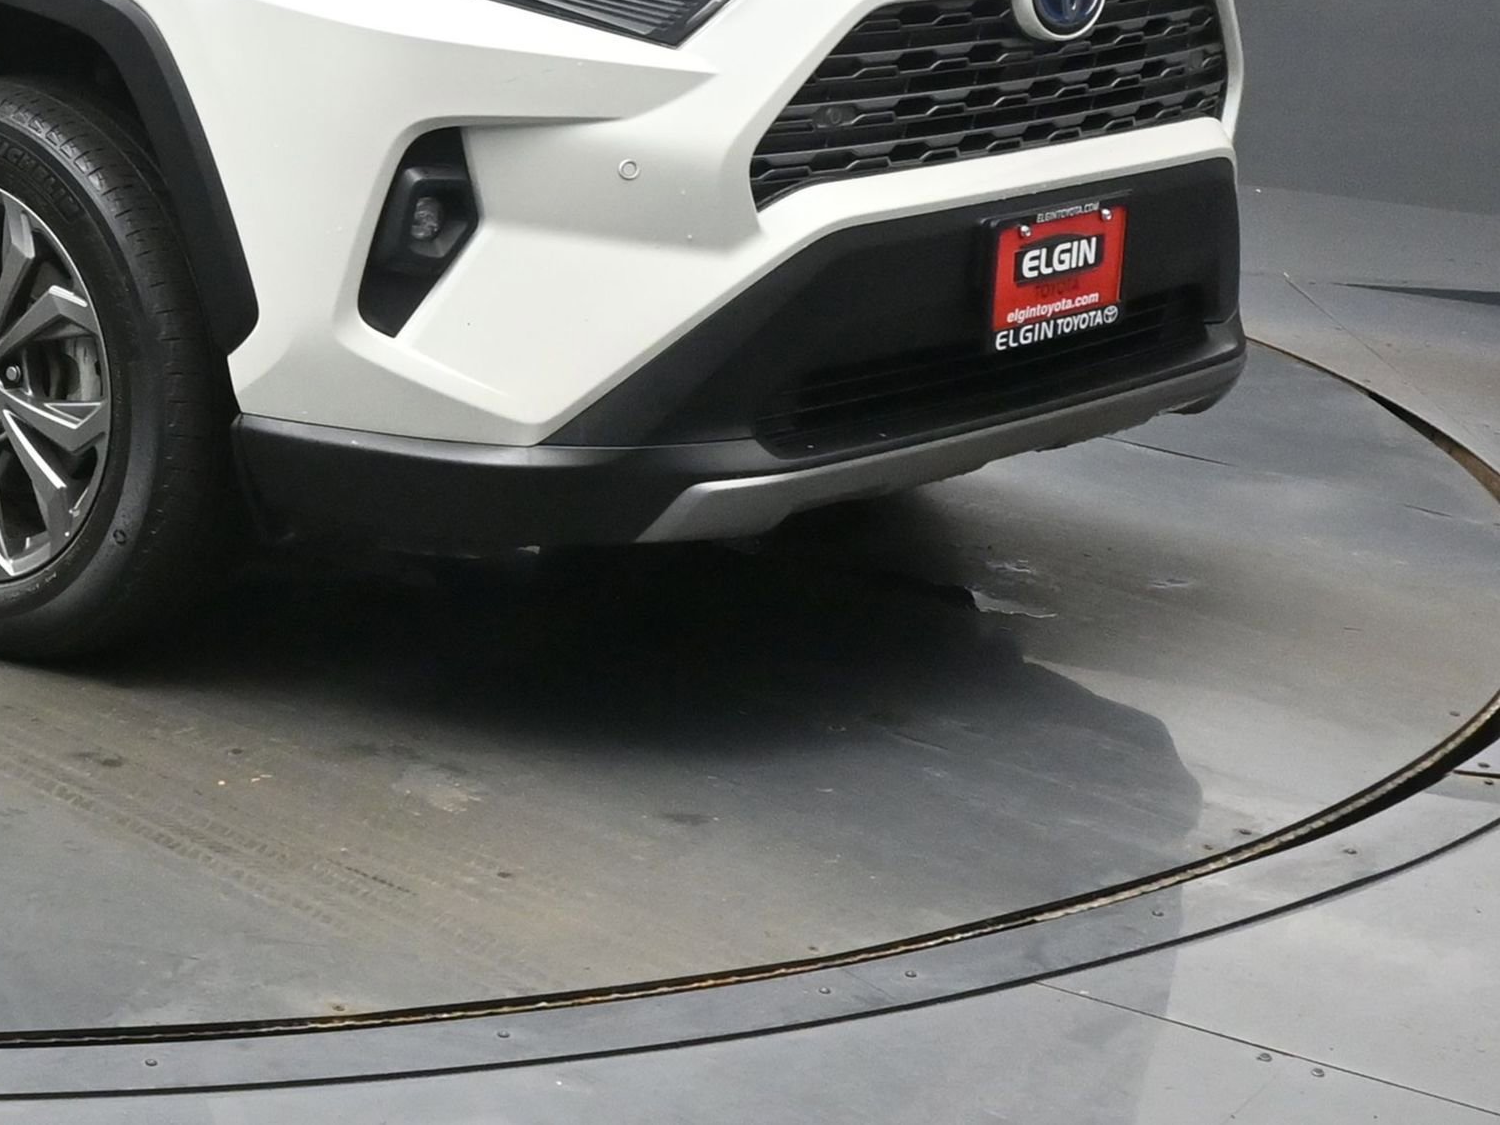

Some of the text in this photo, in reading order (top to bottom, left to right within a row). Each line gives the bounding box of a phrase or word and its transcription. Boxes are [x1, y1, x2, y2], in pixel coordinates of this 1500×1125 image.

[1021, 236, 1097, 279] ELGIN
[1006, 292, 1100, 324] elgintoyota.com
[994, 309, 1104, 352] ELGIN TOYOTA
